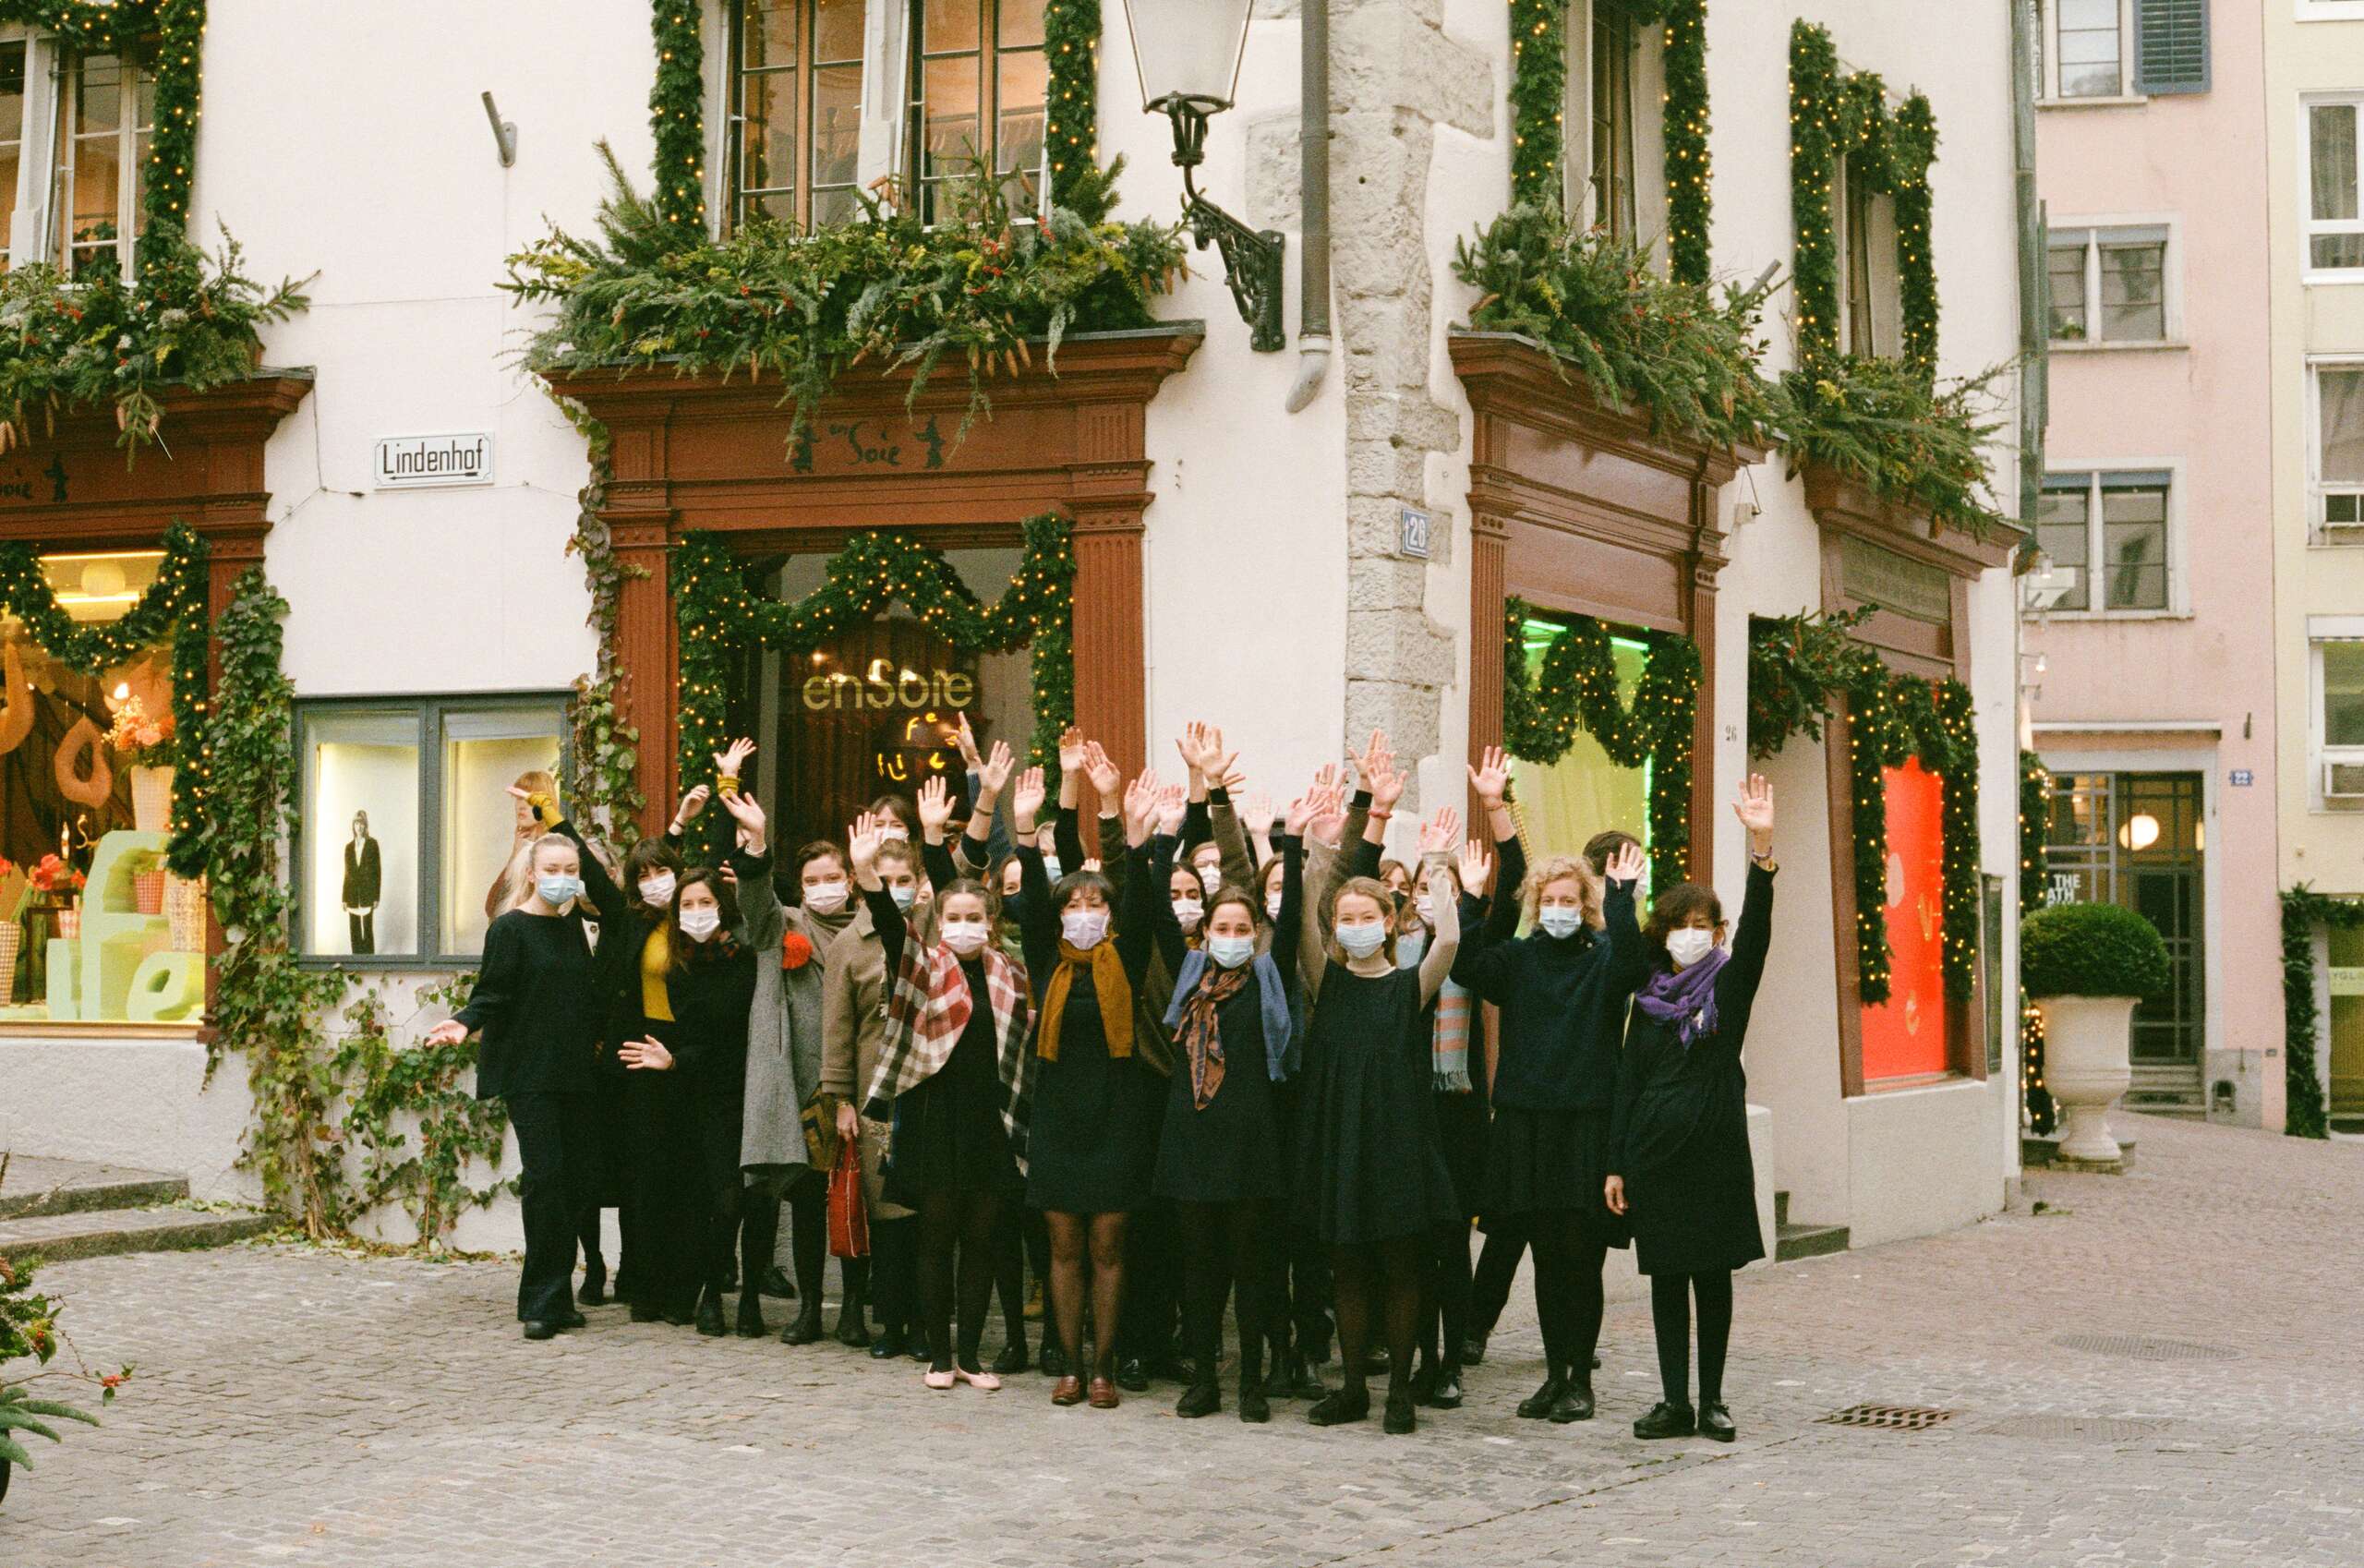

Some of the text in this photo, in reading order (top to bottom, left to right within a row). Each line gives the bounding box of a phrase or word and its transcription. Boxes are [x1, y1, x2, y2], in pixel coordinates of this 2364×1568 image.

[382, 439, 484, 475] Lindenhof
[802, 657, 974, 711] enSoie
[2053, 874, 2081, 888] THE
